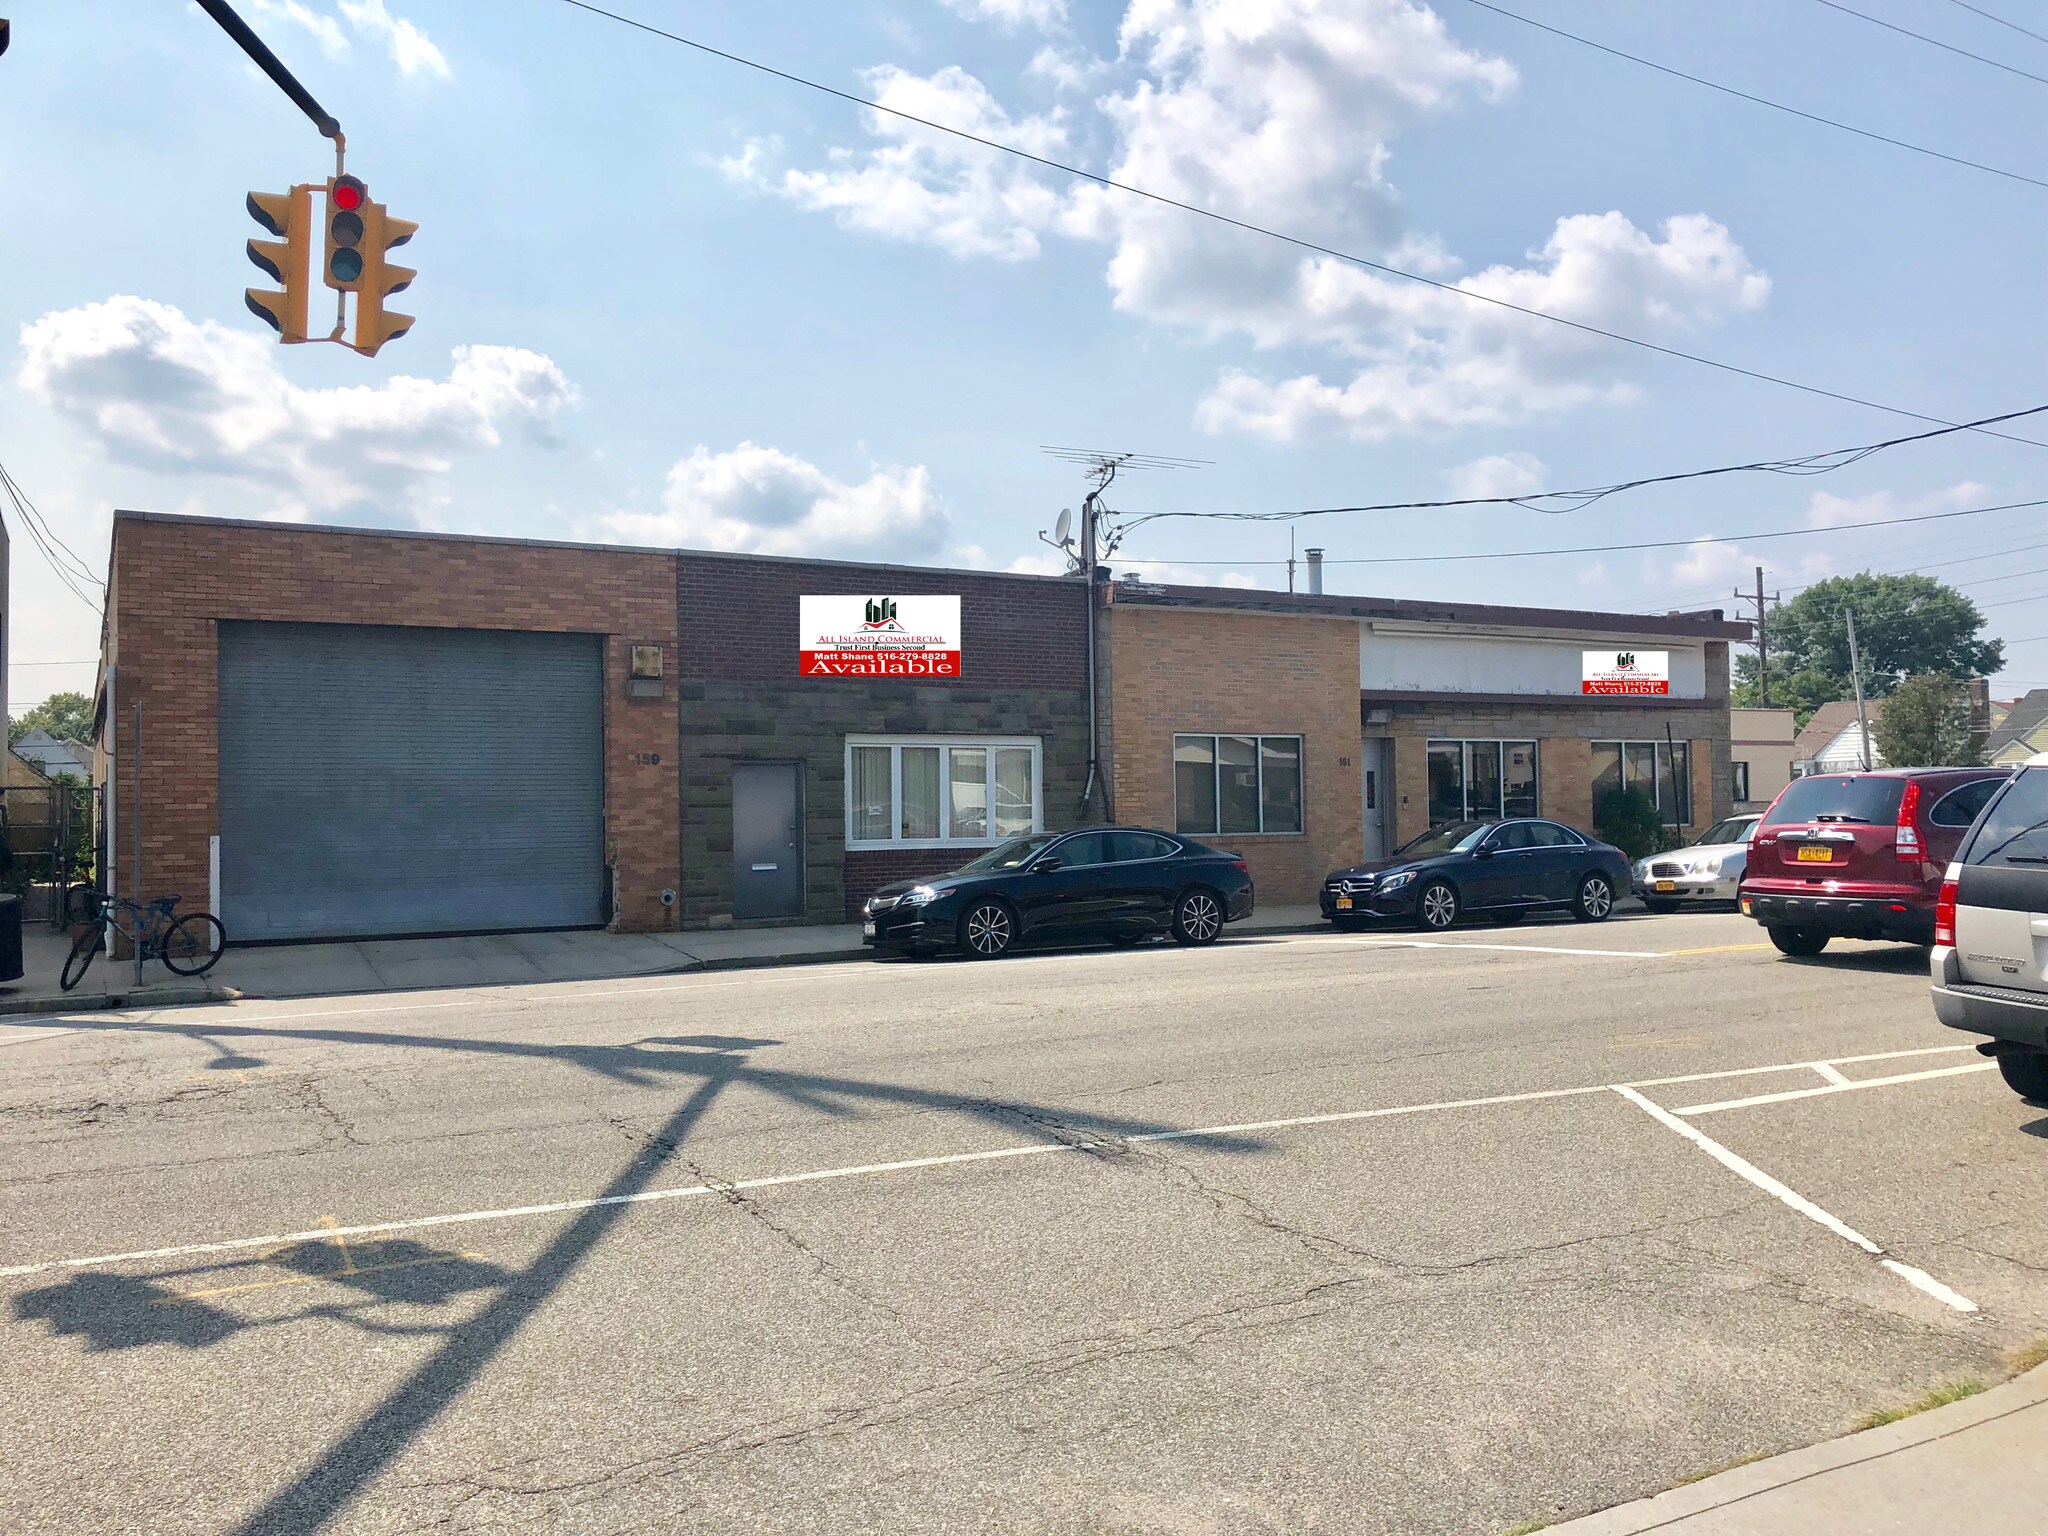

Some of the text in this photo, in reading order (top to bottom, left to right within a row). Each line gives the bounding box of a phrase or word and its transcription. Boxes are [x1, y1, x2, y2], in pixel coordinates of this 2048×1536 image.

[819, 634, 945, 643] ALL ISLAND COMMERCIAL
[807, 660, 953, 674] Available
[634, 753, 660, 765] 159
